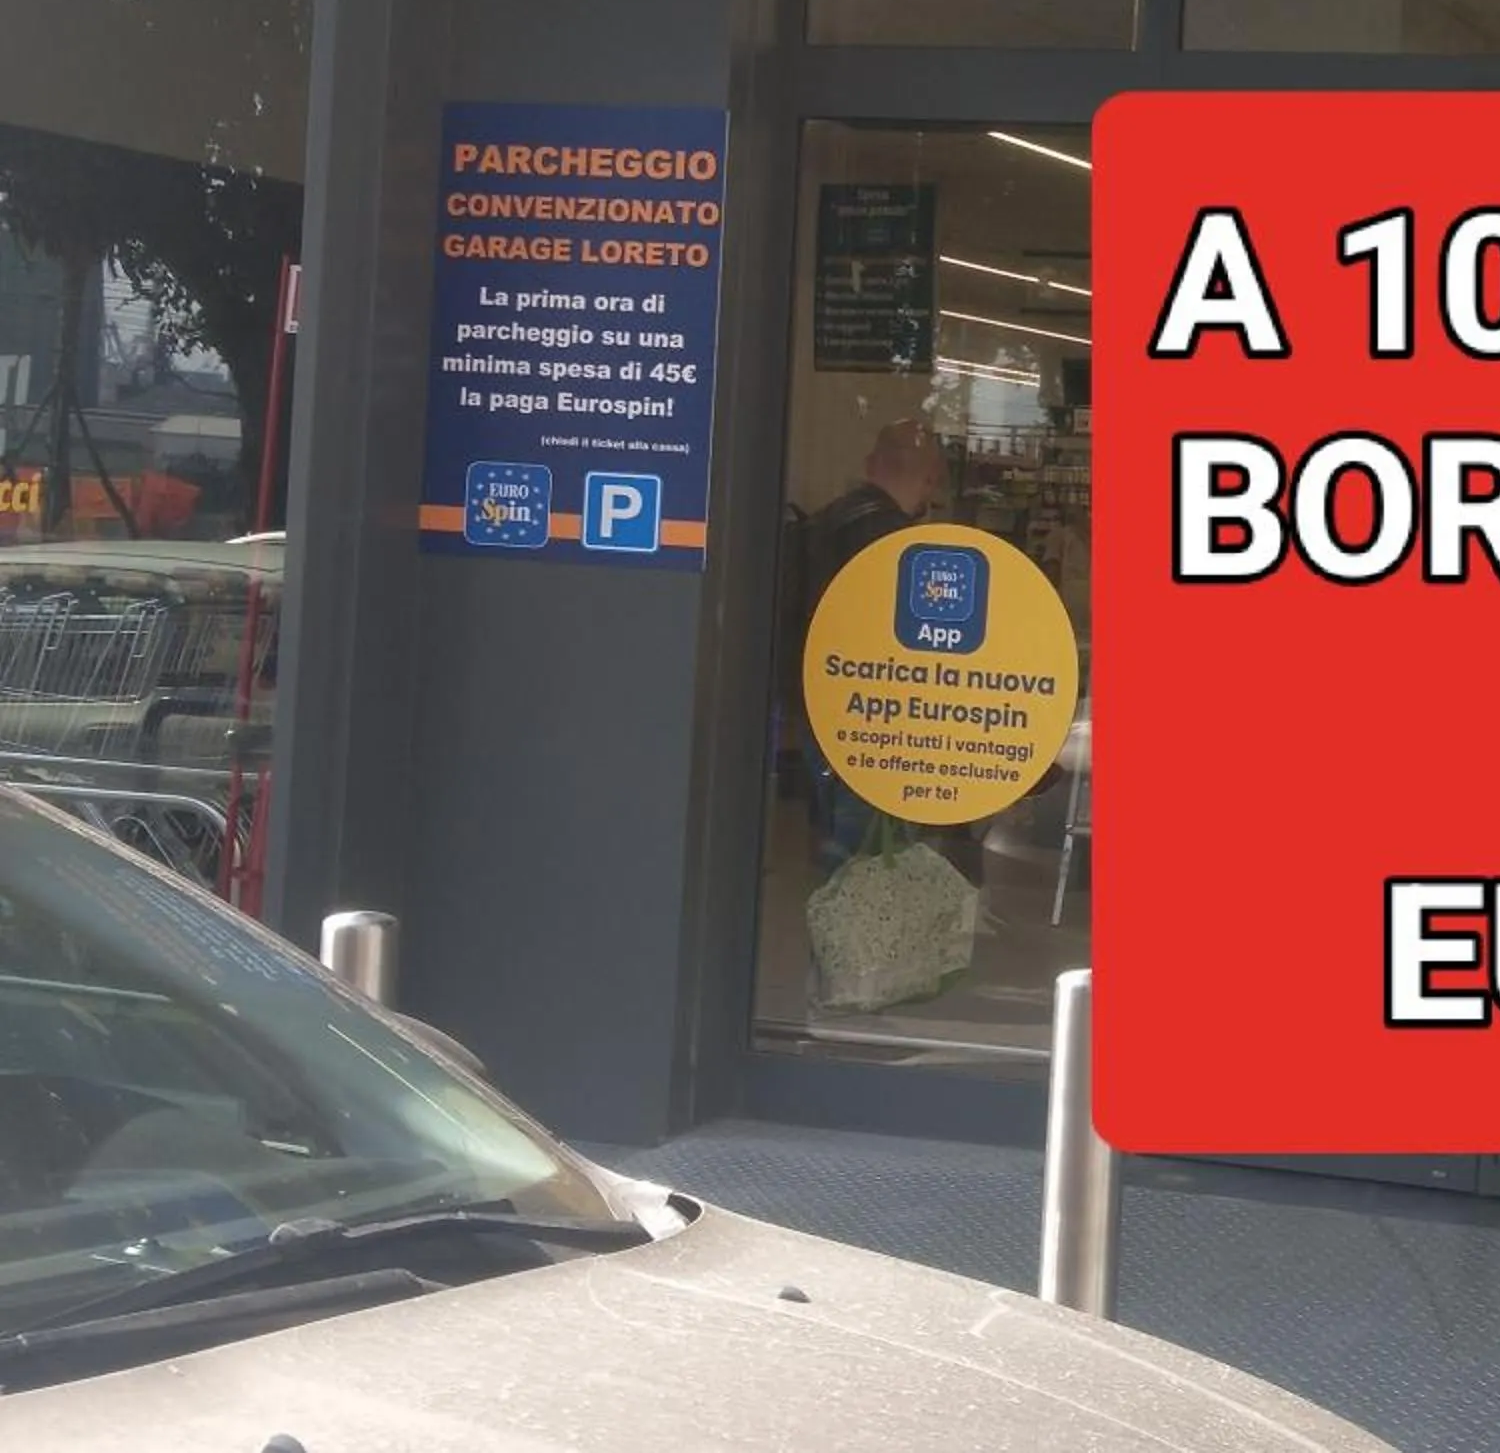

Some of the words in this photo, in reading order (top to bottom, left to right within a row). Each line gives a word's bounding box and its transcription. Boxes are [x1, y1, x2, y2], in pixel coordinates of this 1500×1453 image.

[454, 143, 717, 181] PARCHEGGIO
[447, 192, 720, 226] CONVENZIONATO
[443, 233, 572, 263] GARAGE
[580, 238, 709, 268] LORETO
[479, 286, 509, 306] La
[516, 289, 586, 311] prima
[594, 294, 634, 312] ora
[642, 294, 665, 313] di
[457, 322, 594, 347] parcheggio
[602, 330, 631, 346] su
[639, 331, 684, 348] una
[442, 354, 531, 376] minima
[538, 361, 611, 381] spesa
[619, 360, 642, 380] di
[649, 363, 697, 384] 45€
[459, 387, 481, 407] la
[489, 391, 549, 414] paga
[556, 392, 674, 420] Eurospin!
[488, 482, 530, 498] EURO
[480, 497, 531, 526] Spin
[600, 484, 643, 538] P
[917, 623, 962, 649] App
[825, 654, 928, 684] Scarica
[935, 662, 960, 687] la
[967, 669, 1055, 696] nuova
[847, 692, 900, 724] App
[908, 697, 1028, 733] Eurospin
[837, 729, 847, 741] e
[850, 729, 903, 749] scopri
[907, 734, 943, 750] tutti
[955, 741, 1034, 763] vantaggi
[847, 753, 857, 766] e
[860, 752, 875, 768] le
[879, 755, 935, 774] offerte
[938, 762, 1019, 783] esclusive
[902, 783, 932, 801] per
[935, 785, 958, 801] te!
